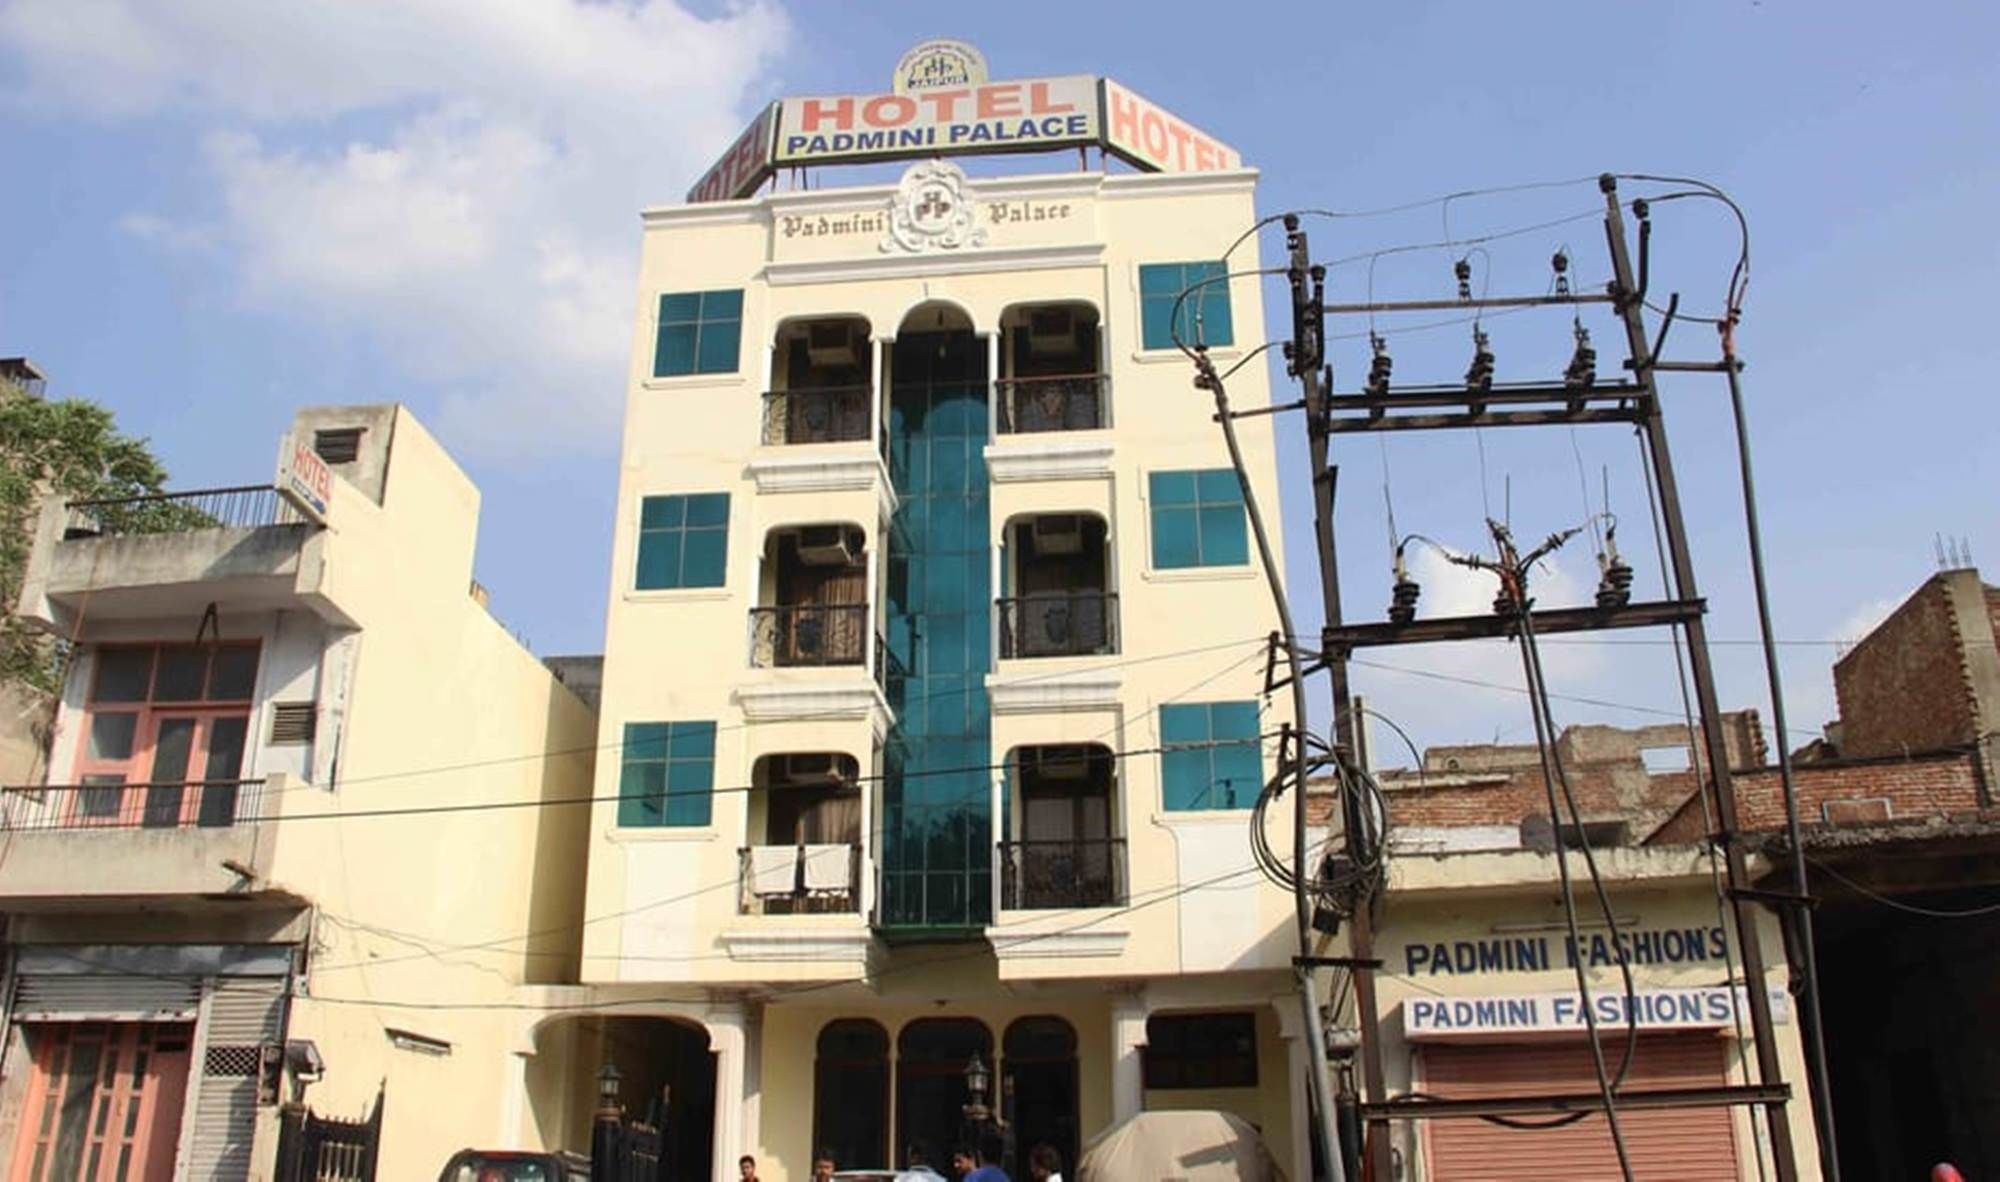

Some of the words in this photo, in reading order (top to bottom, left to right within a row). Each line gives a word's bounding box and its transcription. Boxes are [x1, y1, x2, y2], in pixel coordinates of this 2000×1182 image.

[801, 81, 1074, 132] HOTEL
[786, 125, 936, 155] PADMINI
[949, 114, 1088, 143] PALACE
[783, 212, 883, 238] Padmini
[990, 202, 1070, 224] Palace
[293, 443, 331, 502] HOTEL
[1405, 937, 1550, 977] PADMINI
[1565, 926, 1727, 969] FASHION'S
[1413, 998, 1538, 1029] PADMINI
[1554, 991, 1731, 1026] FASHION'S
